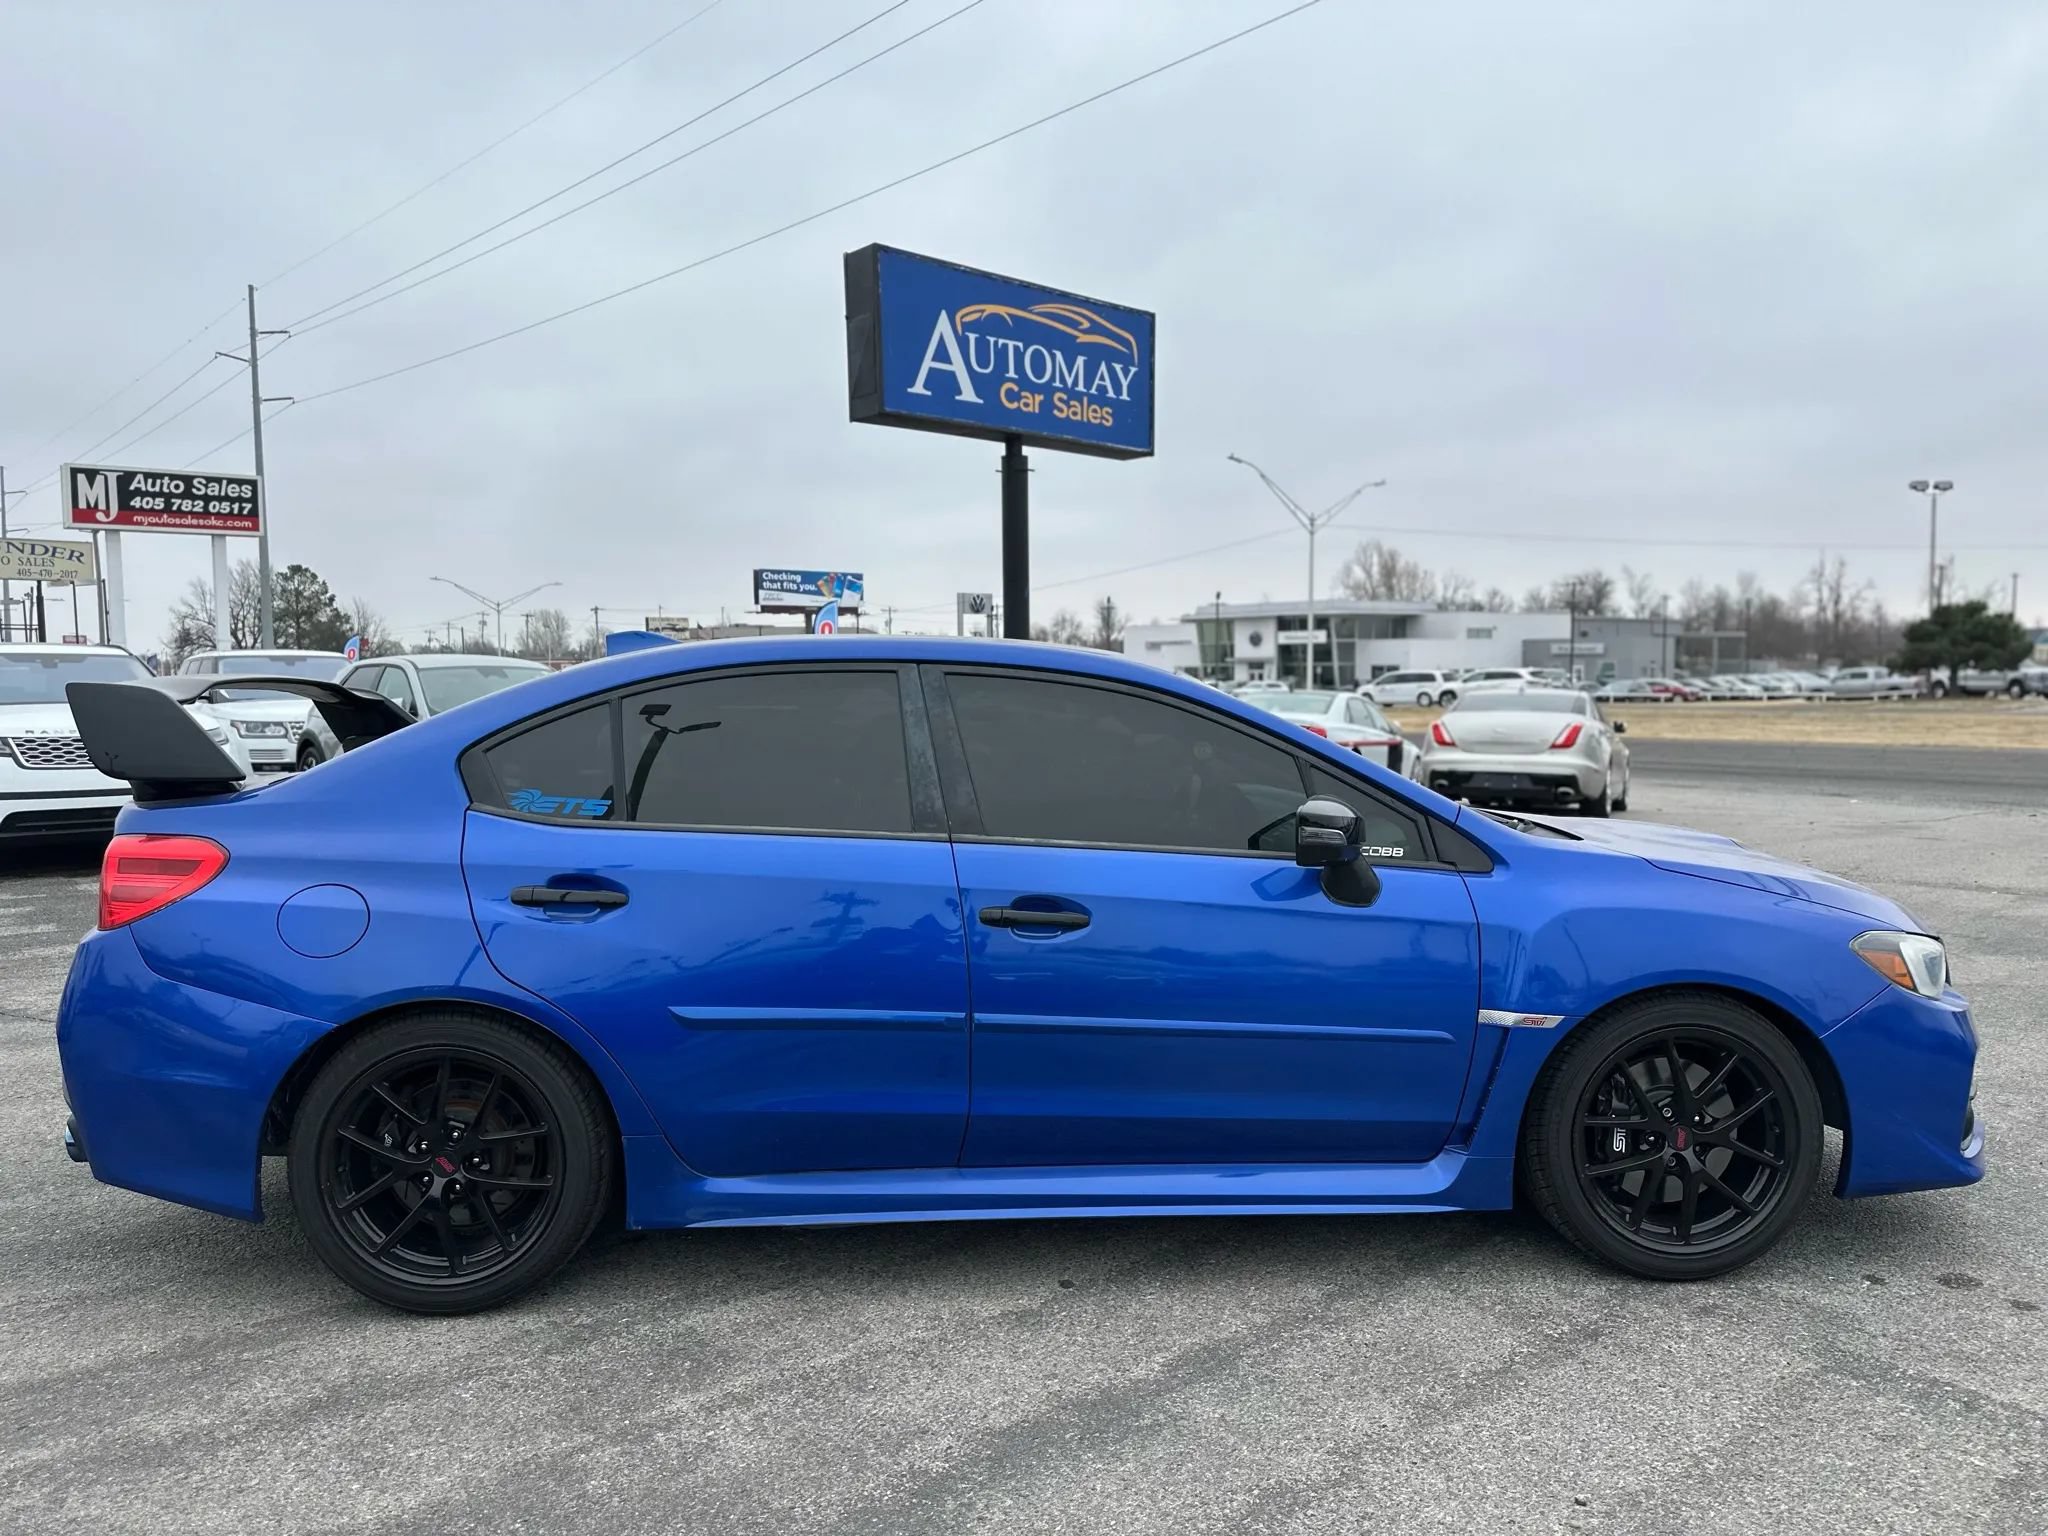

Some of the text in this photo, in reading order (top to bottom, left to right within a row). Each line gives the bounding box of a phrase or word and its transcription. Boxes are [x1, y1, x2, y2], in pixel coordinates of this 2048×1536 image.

[907, 308, 1139, 404] AUTOMAY
[1000, 382, 1113, 427] Car Sales
[129, 473, 253, 498] Auto Sales
[77, 471, 124, 522] MJ
[129, 496, 252, 515] 405 782 0517
[133, 513, 252, 528] mjautosalesokc.com
[0, 541, 86, 565] NDER
[17, 556, 55, 568] SALES
[17, 568, 78, 579] 405-470-2017
[762, 572, 801, 584] Checking
[762, 581, 818, 592] that fits you.
[1360, 846, 1404, 857] COBB
